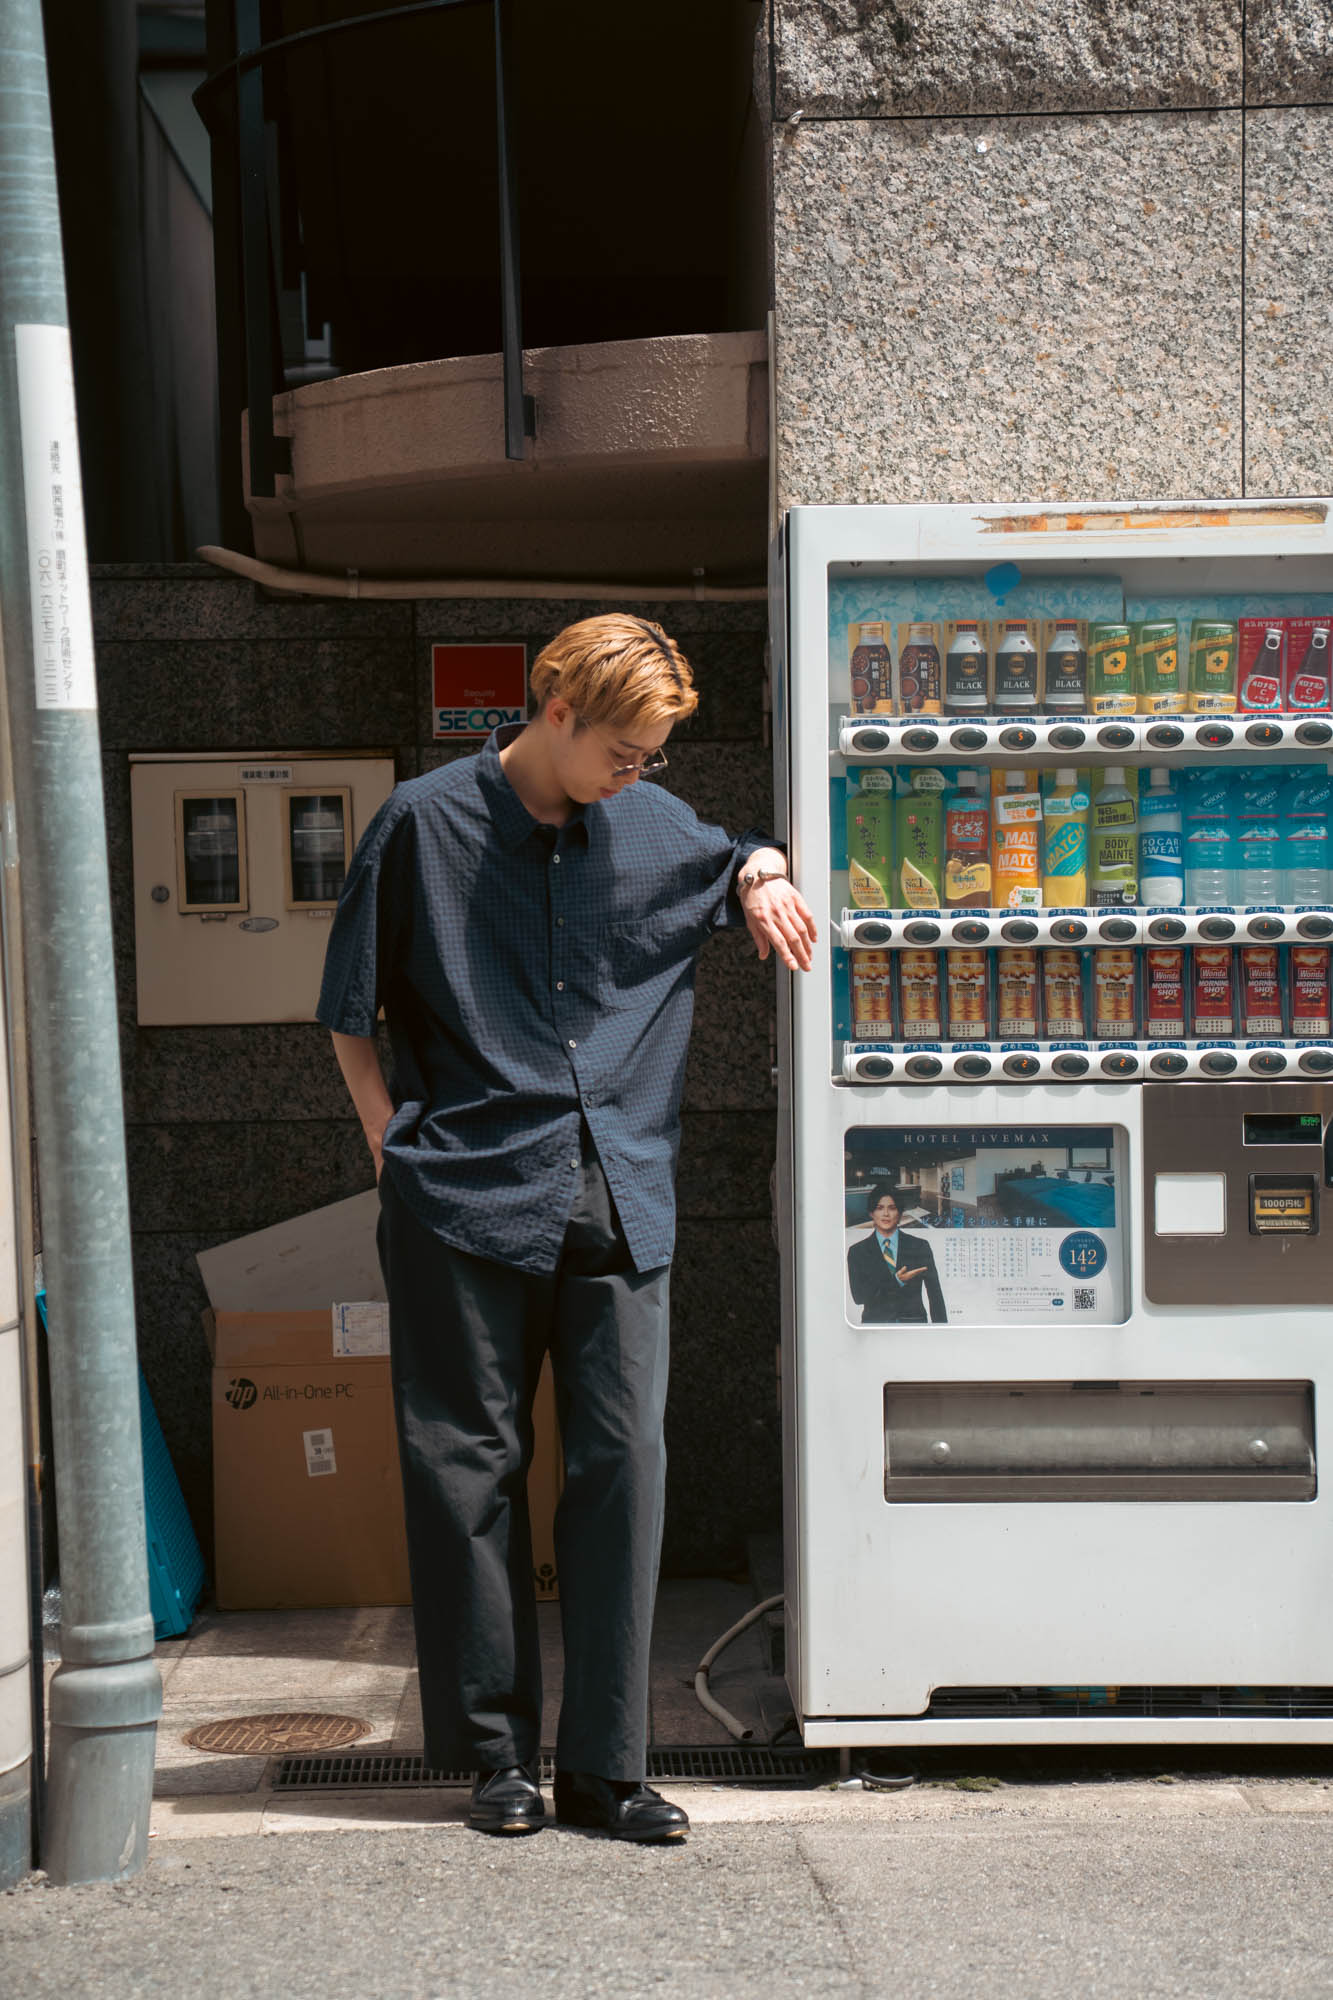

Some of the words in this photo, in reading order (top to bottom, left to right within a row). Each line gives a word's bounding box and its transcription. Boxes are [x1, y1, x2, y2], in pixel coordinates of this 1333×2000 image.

[956, 681, 982, 689] BLACK
[1004, 681, 1030, 689] BLACK
[1056, 680, 1081, 688] BLACK
[439, 709, 520, 730] SECOM
[952, 822, 984, 836] むぎ茶
[1005, 831, 1037, 845] MAT
[1104, 839, 1129, 849] BODY
[1100, 849, 1134, 860] MAINTE
[1142, 845, 1179, 855] SWEAT
[904, 1134, 960, 1143] HOTEL
[971, 1134, 1050, 1143] LiVEMAX
[1069, 1249, 1097, 1265] 142
[263, 1384, 332, 1400] All-in-One
[335, 1384, 354, 1398] PC
